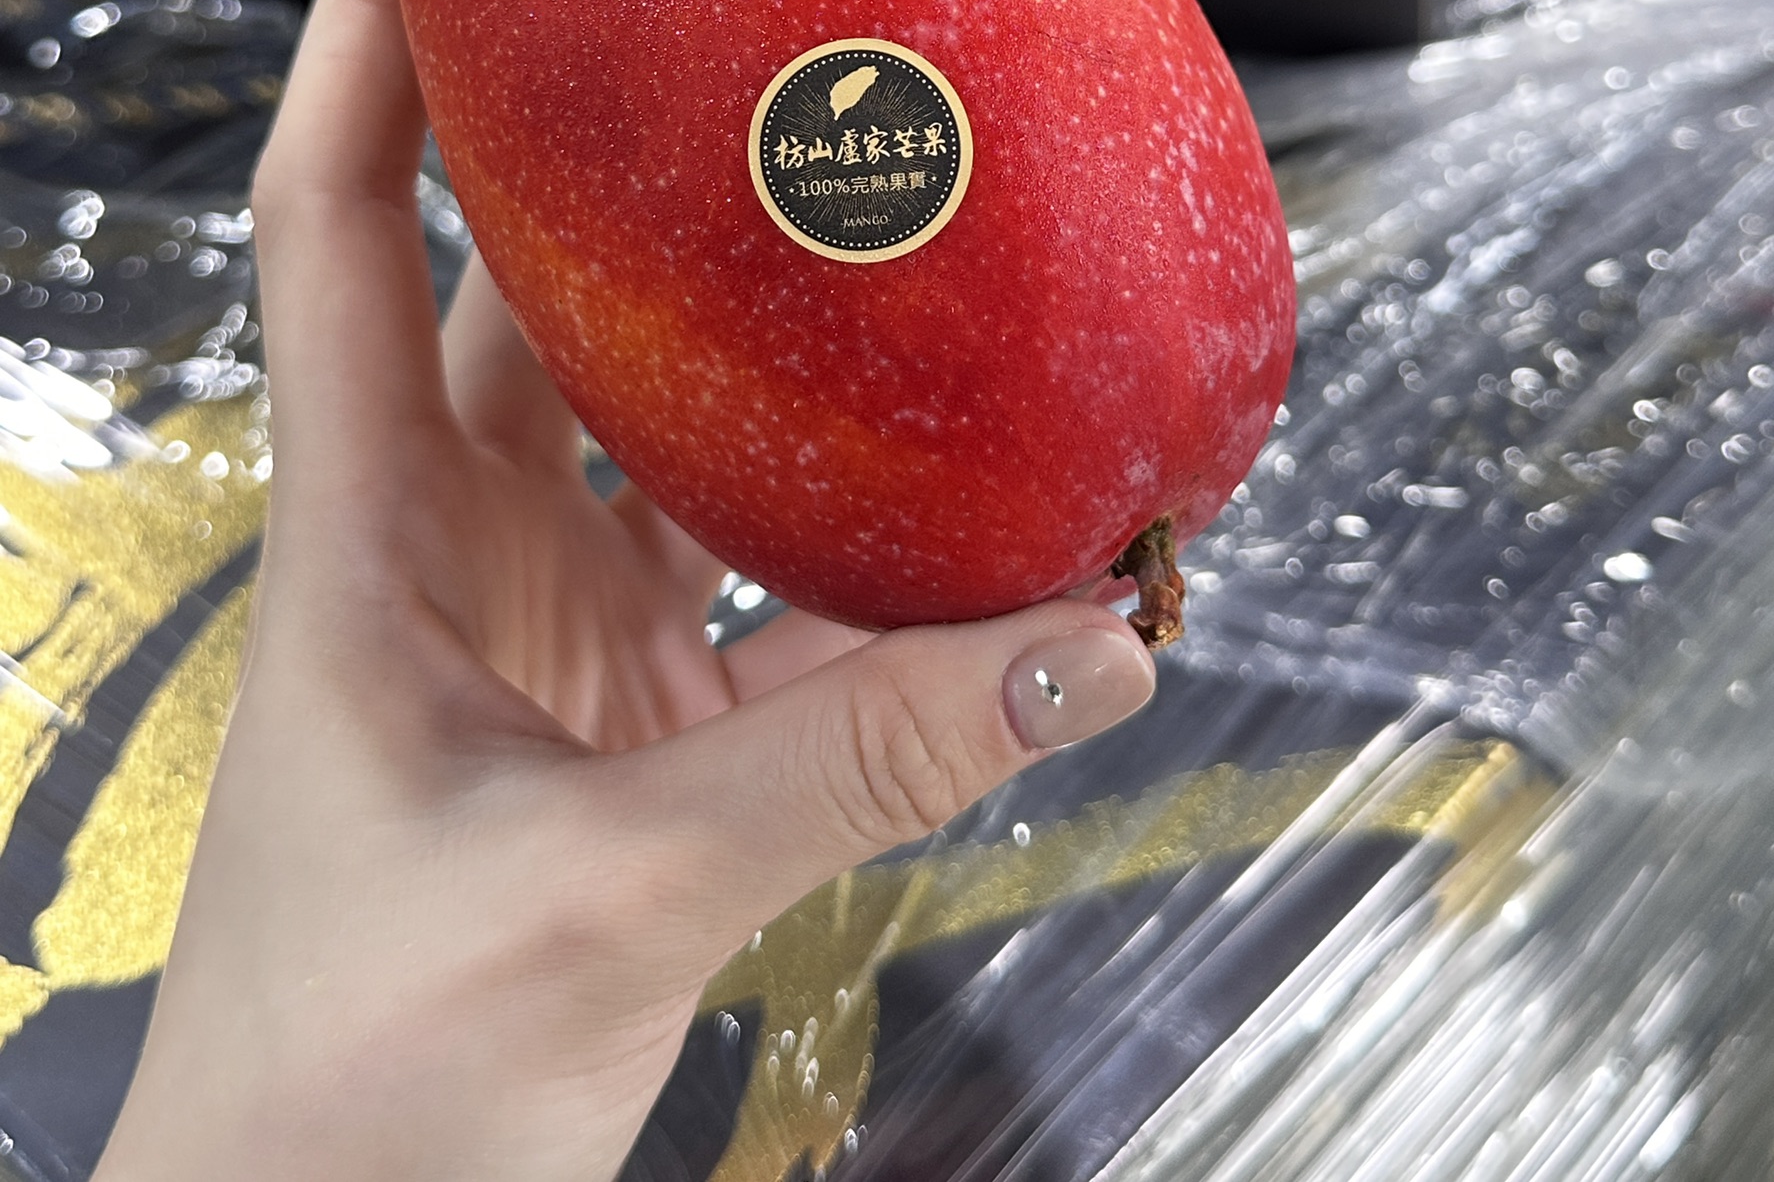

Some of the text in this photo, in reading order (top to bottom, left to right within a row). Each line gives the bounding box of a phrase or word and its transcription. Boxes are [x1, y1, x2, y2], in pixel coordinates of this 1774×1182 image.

[773, 123, 947, 170] 枋山盧家芒果
